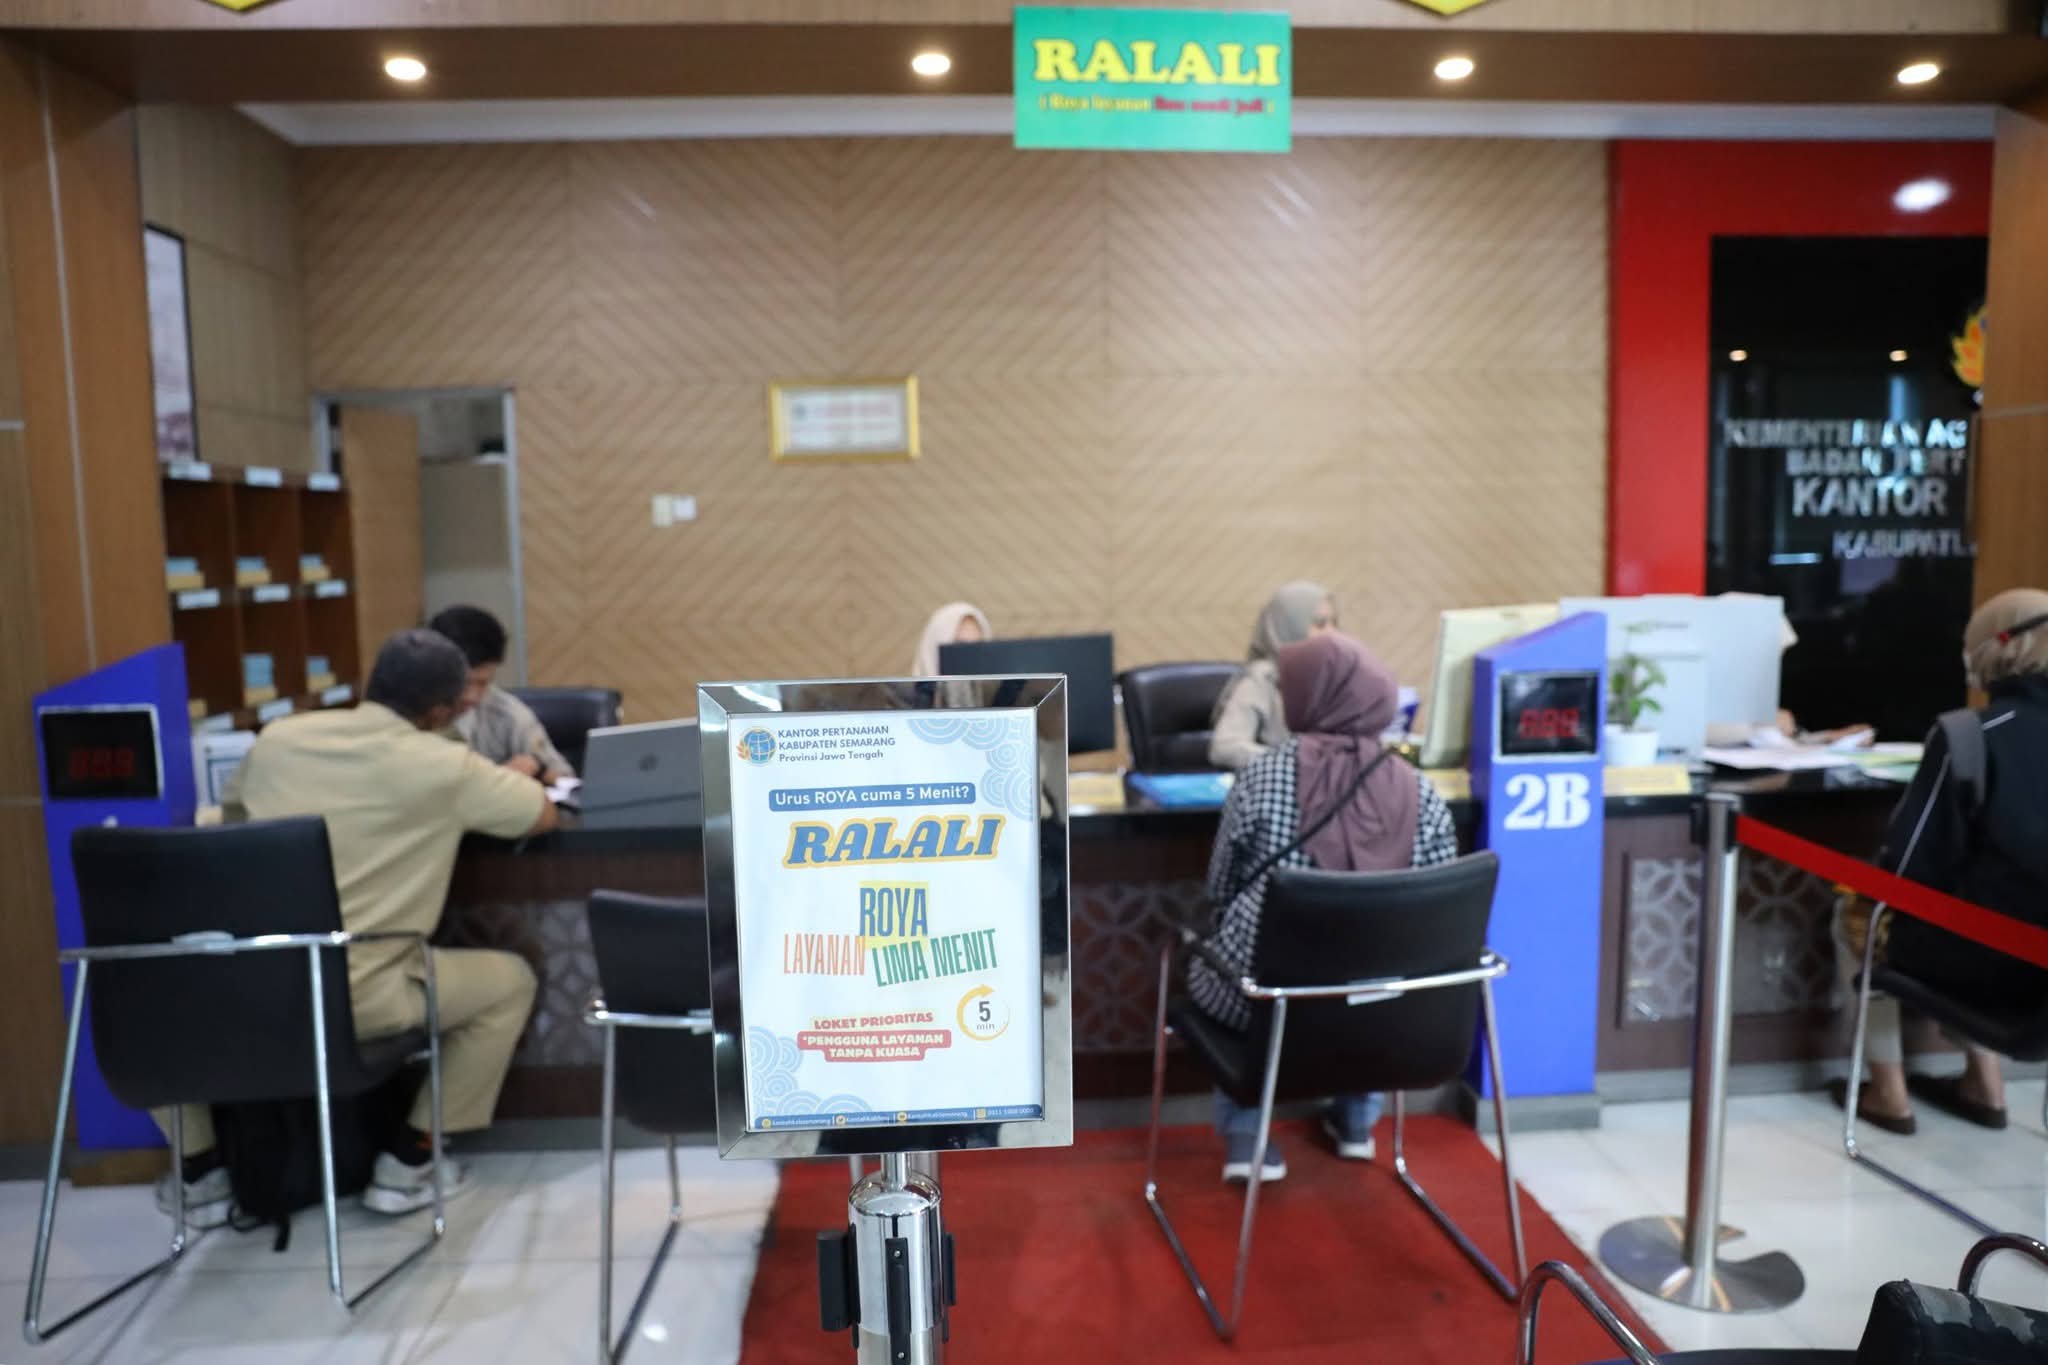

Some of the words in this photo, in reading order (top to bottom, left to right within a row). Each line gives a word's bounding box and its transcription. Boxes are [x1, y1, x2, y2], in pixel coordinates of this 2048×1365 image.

[1033, 39, 1281, 86] RALALI
[1785, 447, 1883, 476] BADAN
[1792, 476, 1949, 517] KANTOR
[777, 728, 820, 739] KANTOR
[822, 725, 889, 737] PERTANAHAN
[778, 739, 837, 751] KABUPATEN
[839, 737, 896, 748] SEMARANG
[779, 752, 818, 762] Provinsi
[819, 752, 846, 761] Jawa
[848, 749, 884, 761] Tengah
[775, 792, 811, 805] Urus
[815, 790, 857, 803] ROYA
[860, 791, 901, 802] cuma
[906, 788, 915, 800] 5
[919, 785, 970, 800] Menit?
[1503, 772, 1592, 831] 2B
[785, 817, 1003, 866] RALALI
[859, 887, 928, 937] ROYA
[783, 933, 866, 976] LAYANAN
[872, 940, 929, 988] LIMA
[930, 928, 998, 978] MENIT
[814, 1018, 857, 1030] LOKET
[860, 1012, 934, 1027] PRIORITAS
[978, 1000, 991, 1022] 5
[976, 1022, 995, 1031] min
[882, 1034, 944, 1045] LAYANAN
[829, 1048, 873, 1058] TANPA
[875, 1046, 920, 1057] KUASA
